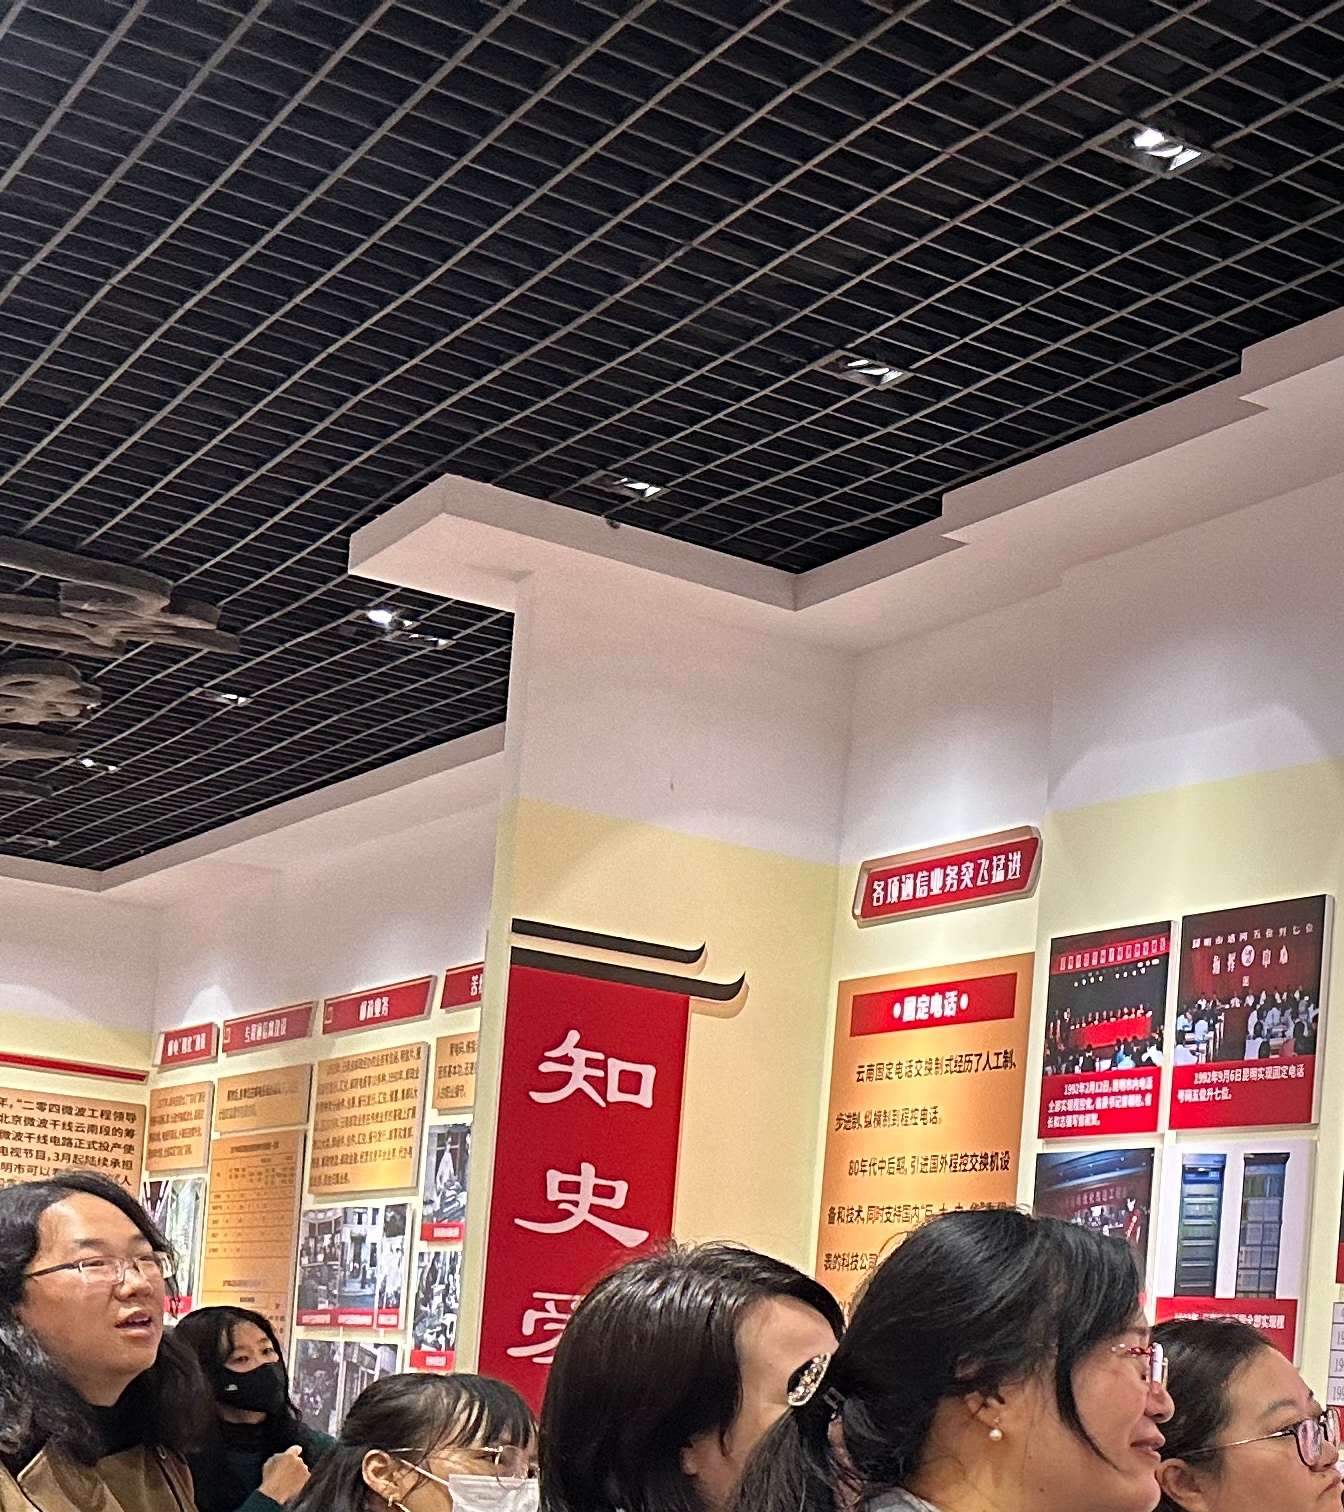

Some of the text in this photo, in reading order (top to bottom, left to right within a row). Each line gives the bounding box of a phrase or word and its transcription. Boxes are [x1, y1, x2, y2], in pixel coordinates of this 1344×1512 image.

[872, 851, 1022, 907] 各项通信业务突飞猛进
[902, 990, 959, 1022] 固定电话
